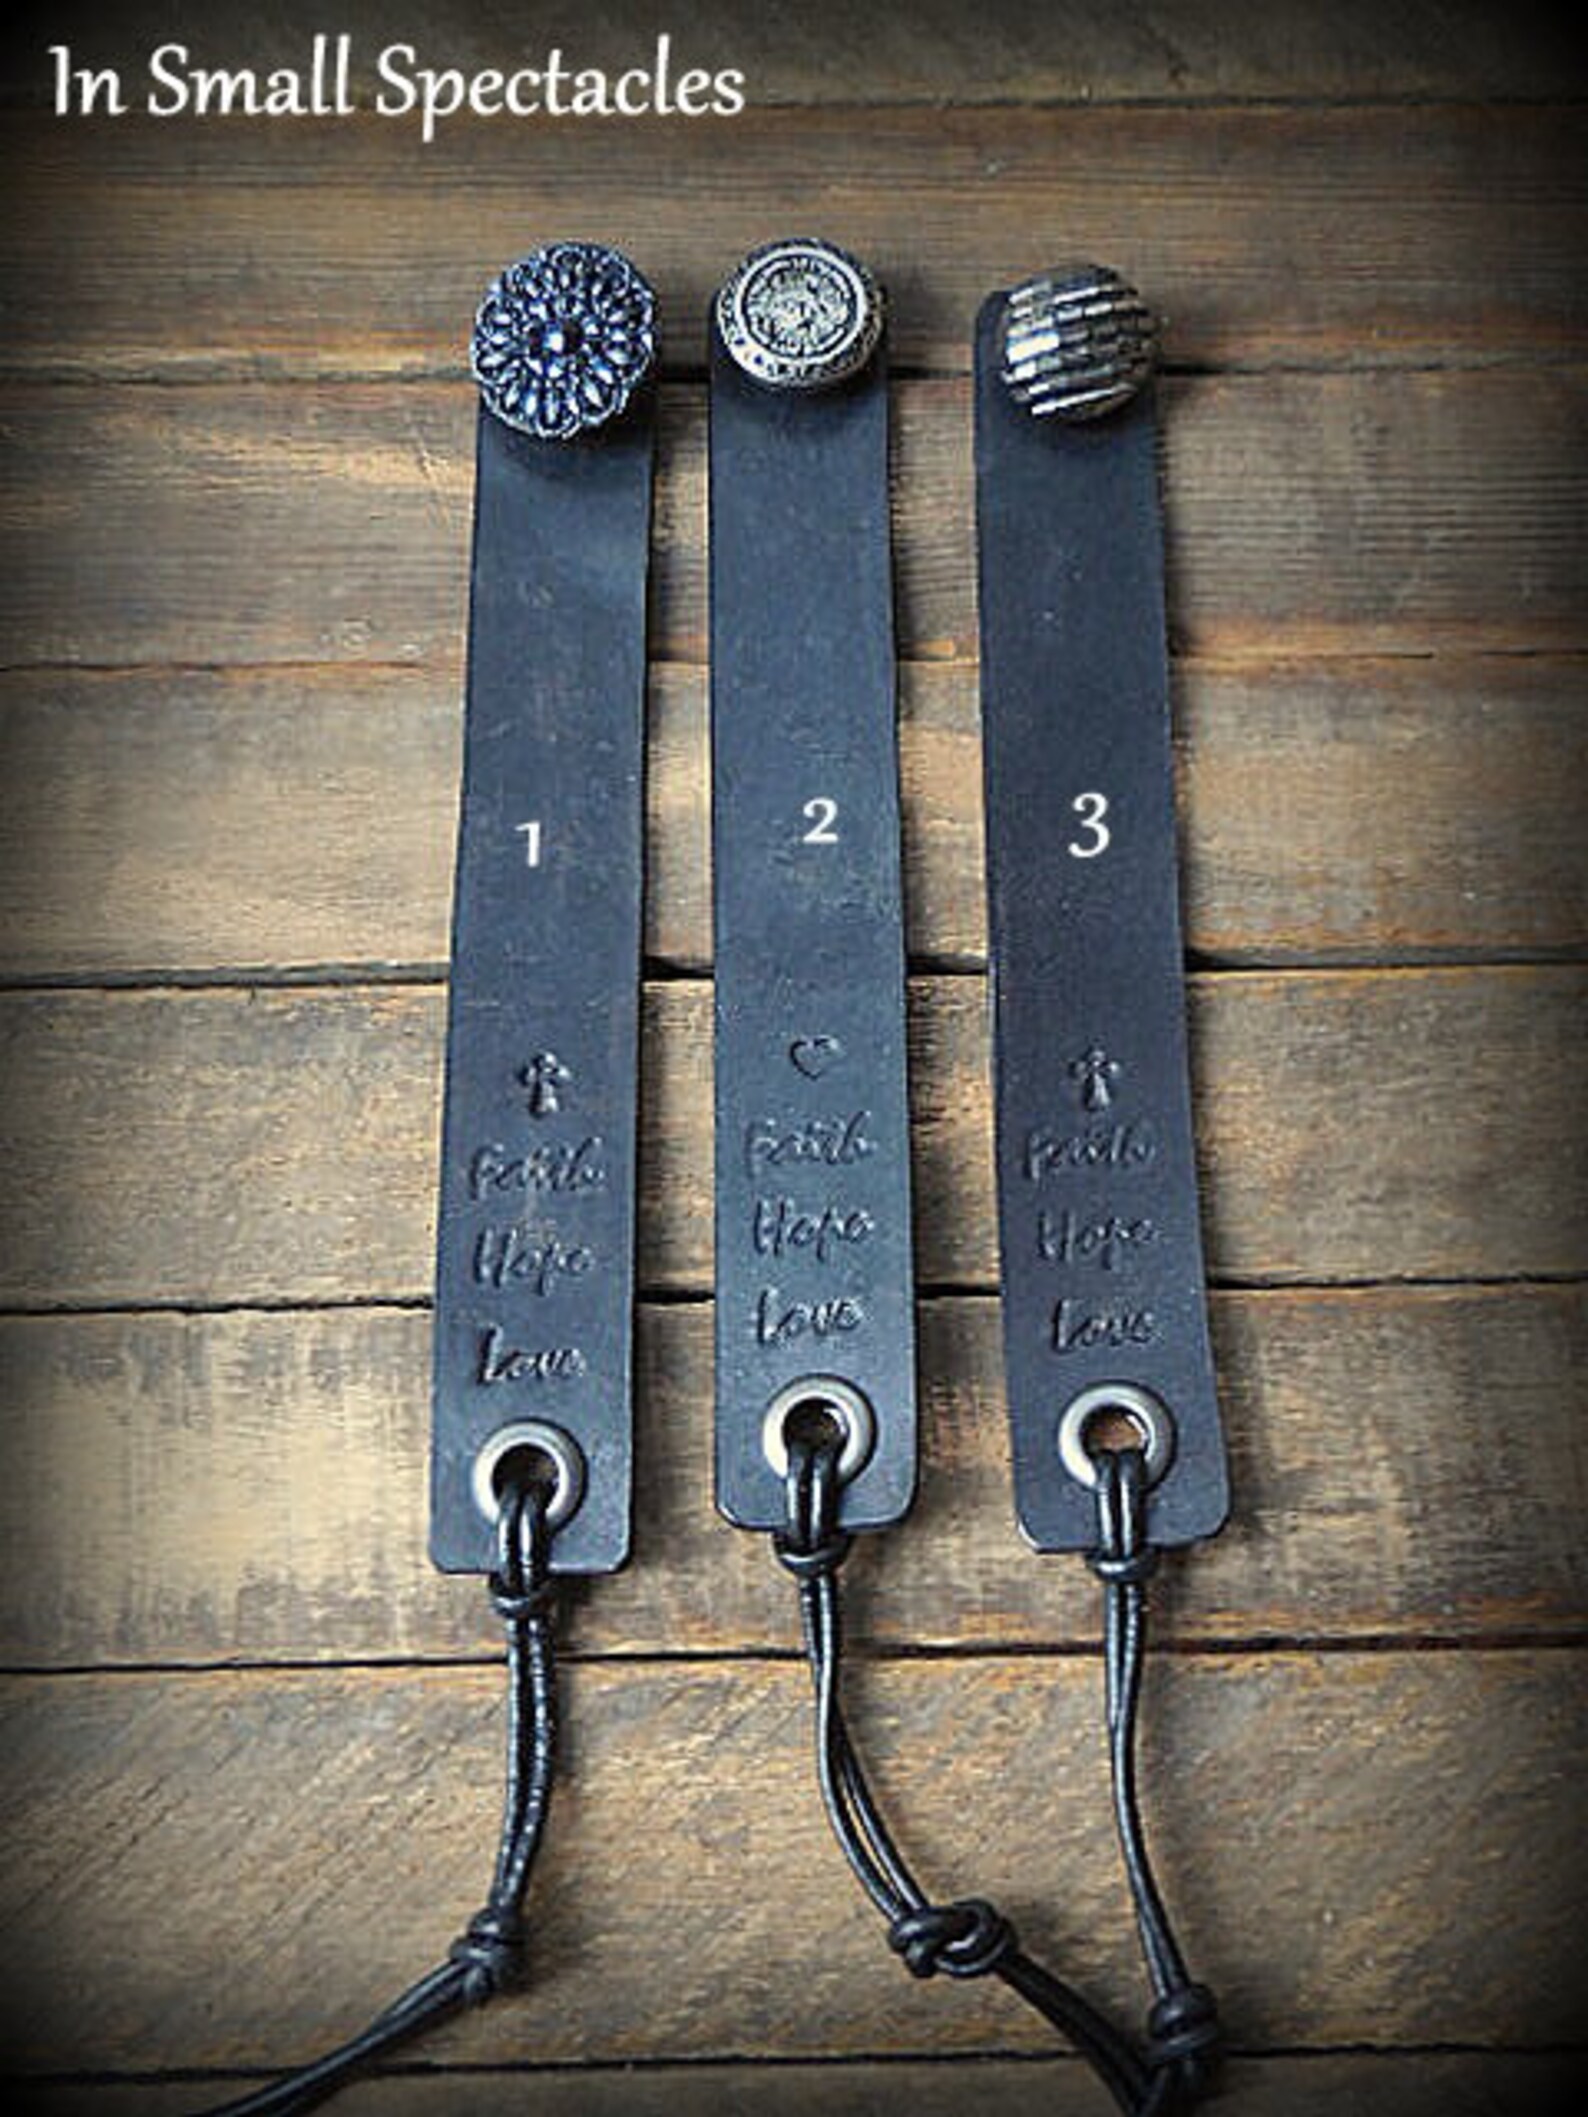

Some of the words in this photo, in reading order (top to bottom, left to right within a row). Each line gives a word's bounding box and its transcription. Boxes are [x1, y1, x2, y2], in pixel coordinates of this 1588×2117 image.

[470, 1137, 604, 1199] Faith
[743, 1110, 876, 1179] Faith
[1022, 1124, 1156, 1180] Faith
[473, 1227, 595, 1297] Hope
[753, 1199, 875, 1263] Hope
[1038, 1210, 1158, 1271] Hope
[756, 1287, 865, 1346] Love
[1053, 1299, 1164, 1355] Love
[476, 1323, 587, 1385] Love
